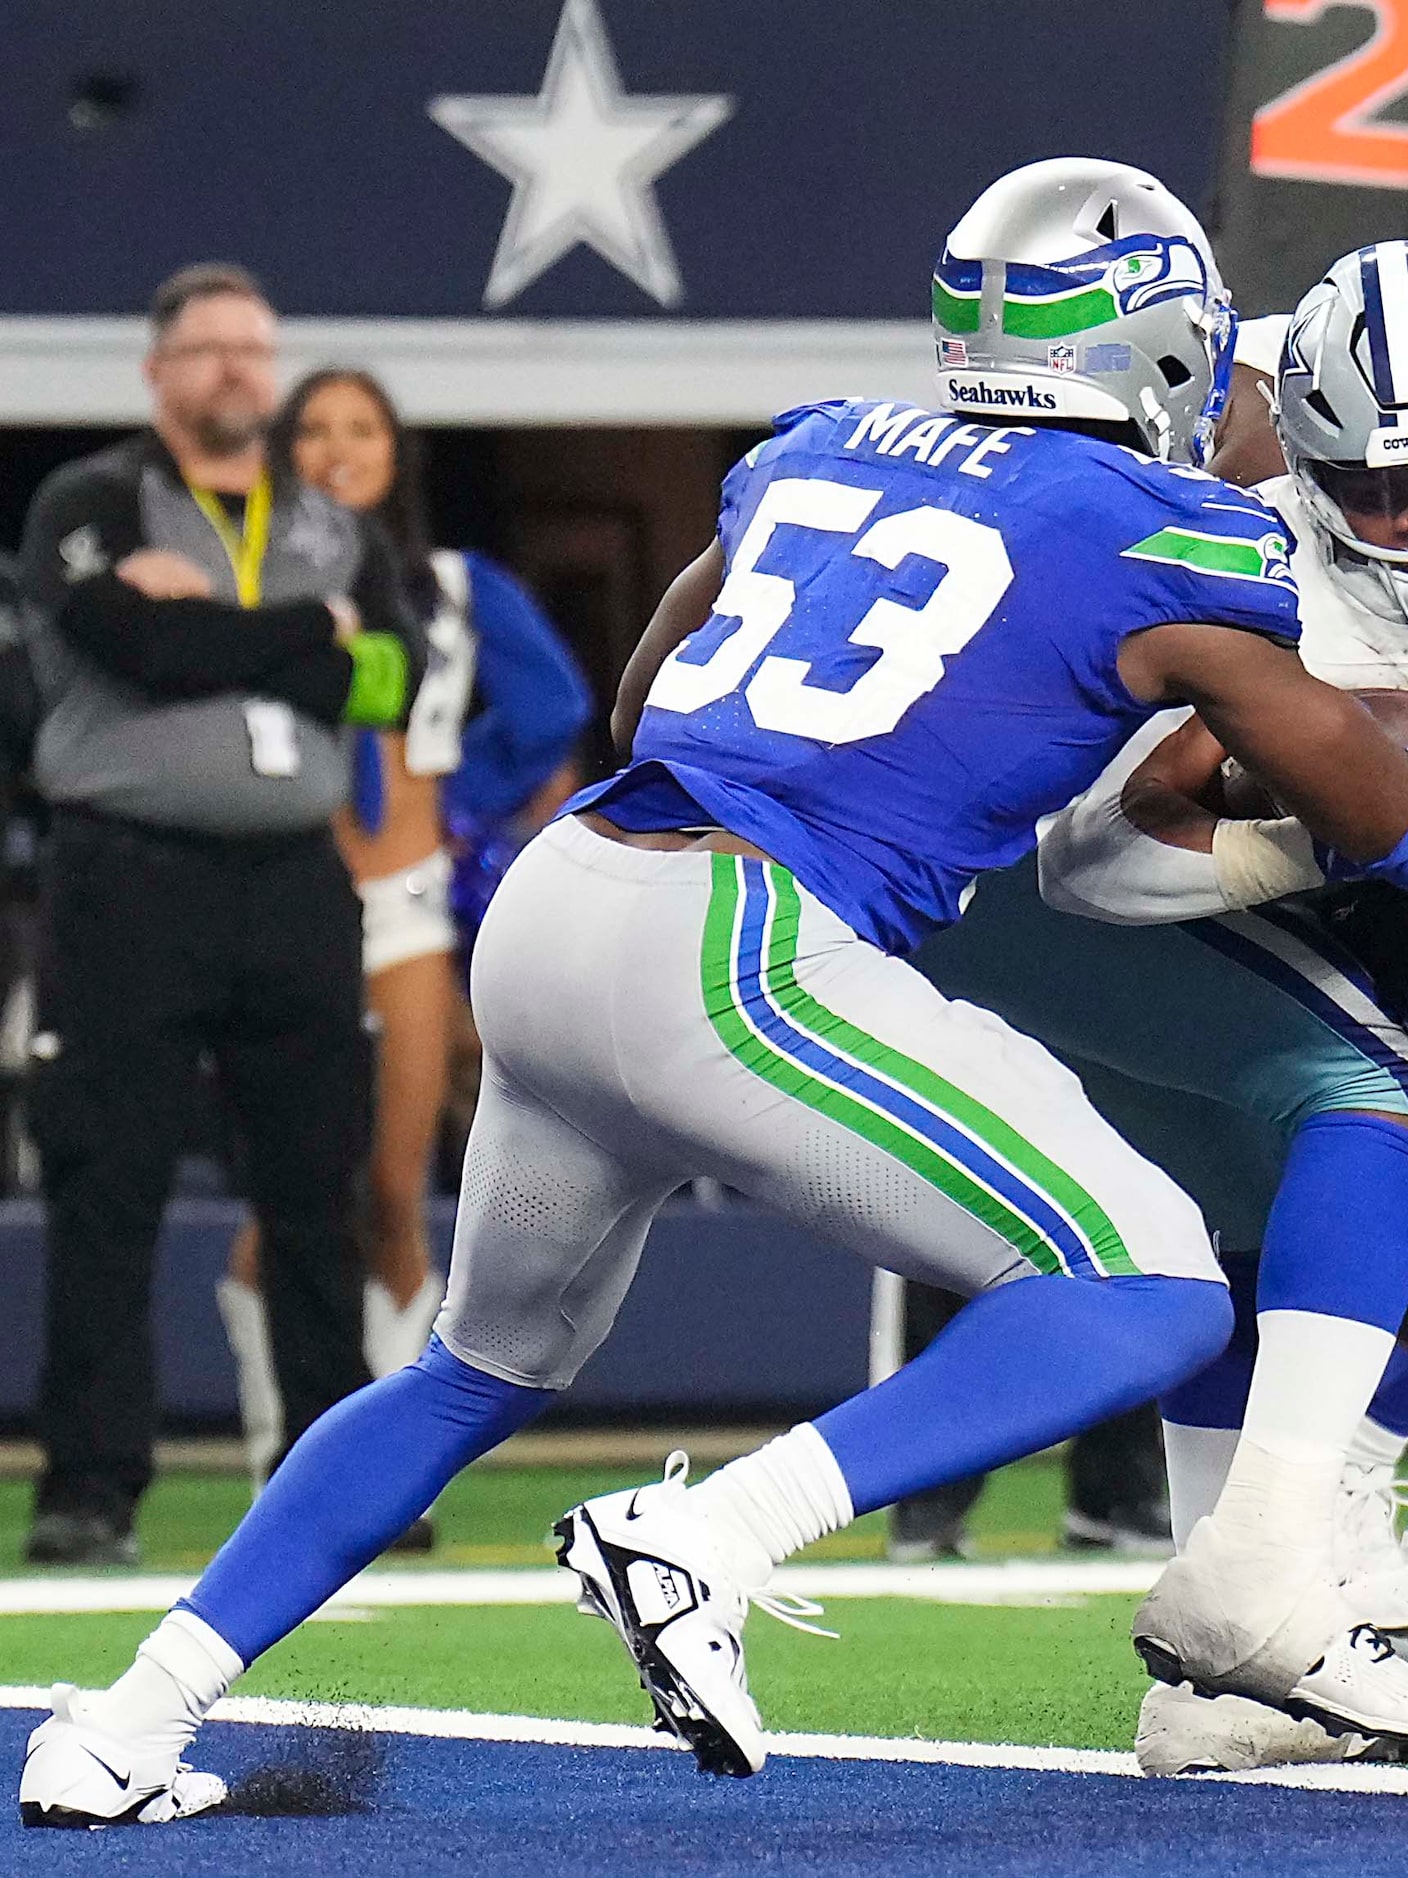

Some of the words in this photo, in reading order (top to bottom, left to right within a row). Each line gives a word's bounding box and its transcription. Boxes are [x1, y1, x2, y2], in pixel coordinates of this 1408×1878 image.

[949, 378, 1057, 409] Seahawks
[1052, 359, 1074, 373] NFL
[844, 401, 1037, 480] MAFE
[643, 477, 1015, 745] 53
